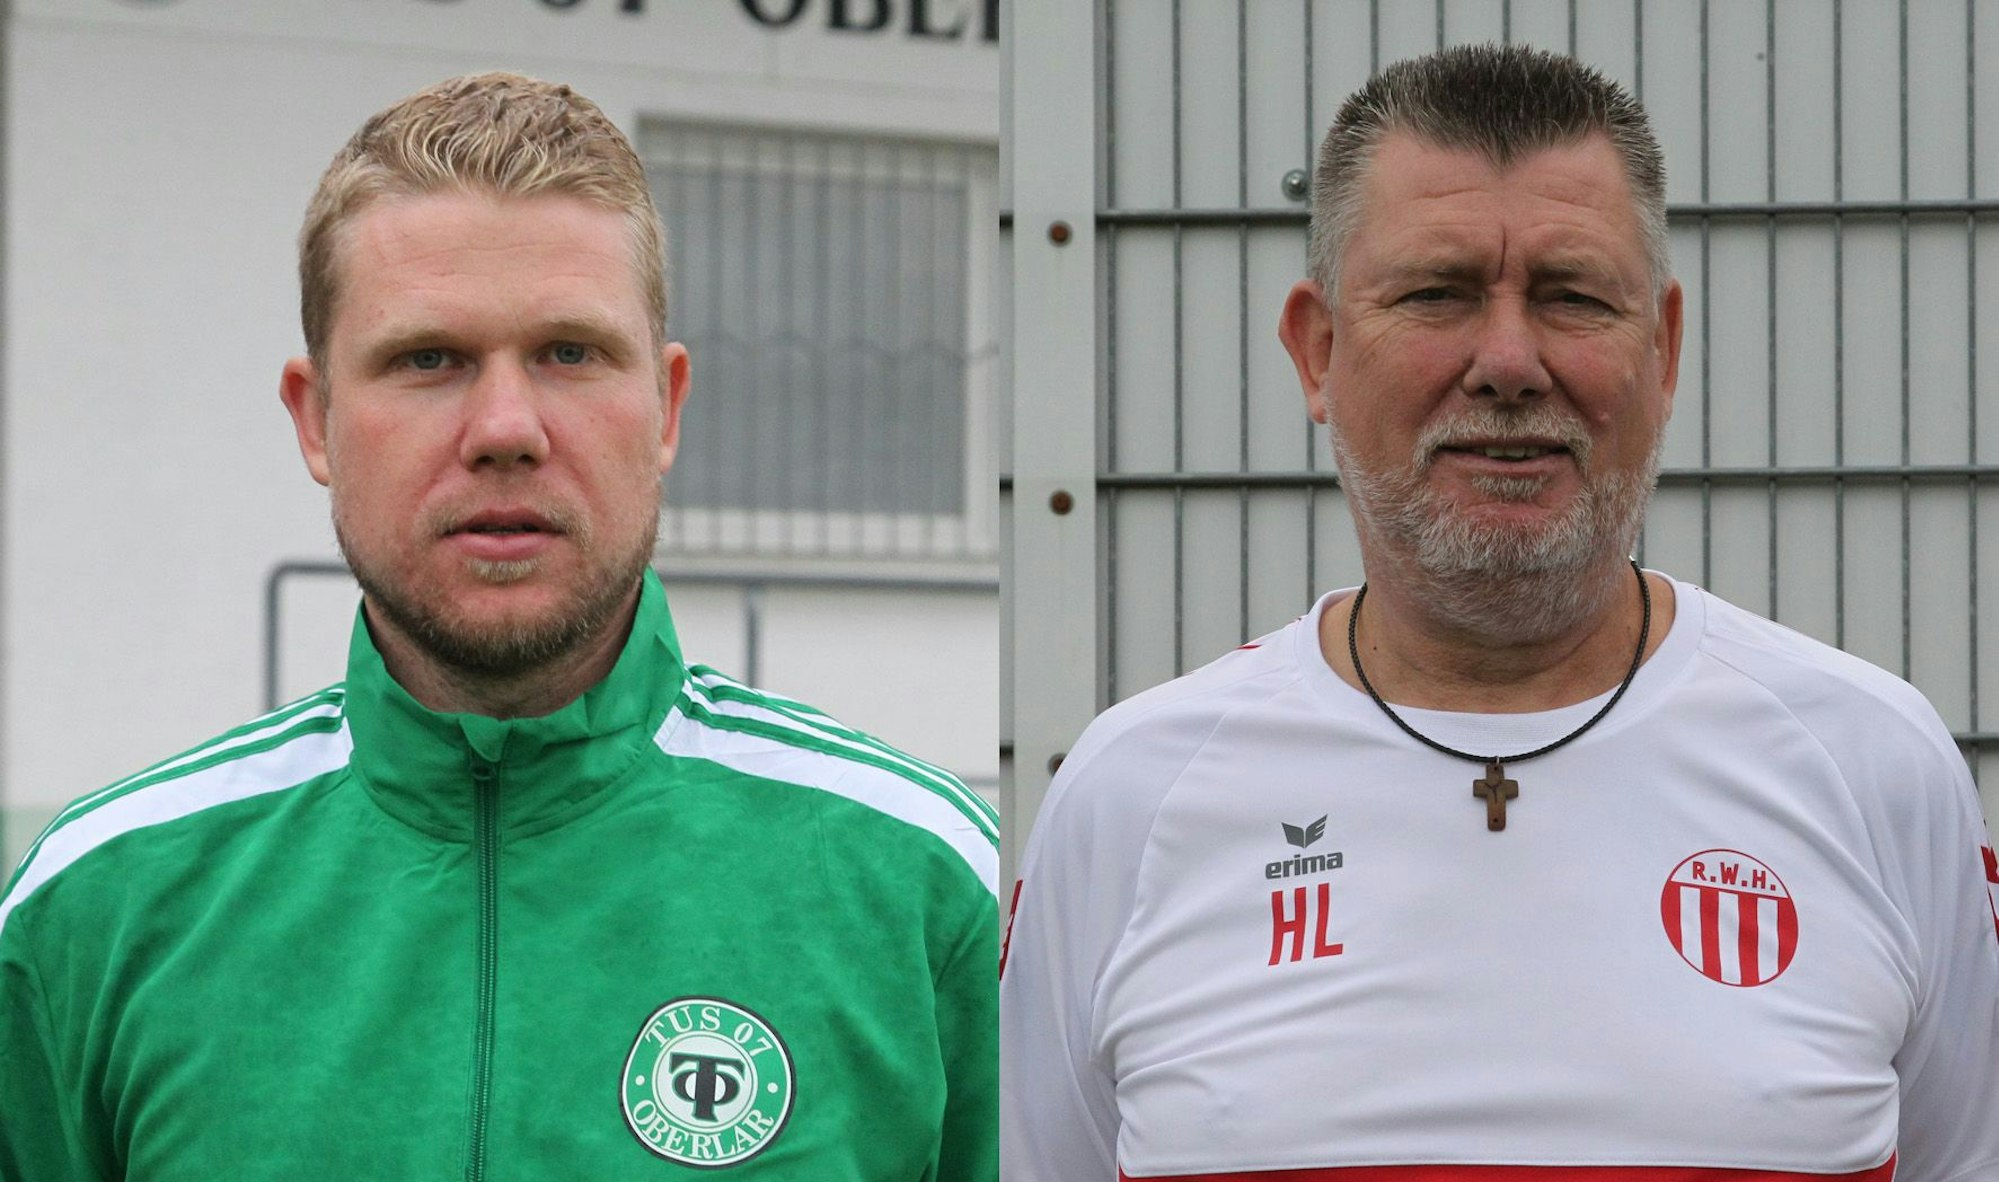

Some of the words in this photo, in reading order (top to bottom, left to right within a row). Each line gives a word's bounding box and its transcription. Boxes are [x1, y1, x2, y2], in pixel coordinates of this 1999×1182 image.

[1265, 851, 1343, 880] erima
[1692, 860, 1777, 892] R.W.H.
[1268, 882, 1343, 966] HL
[645, 1006, 720, 1048] TUS
[734, 1022, 773, 1057] 07
[632, 1099, 774, 1159] OBERLAR
